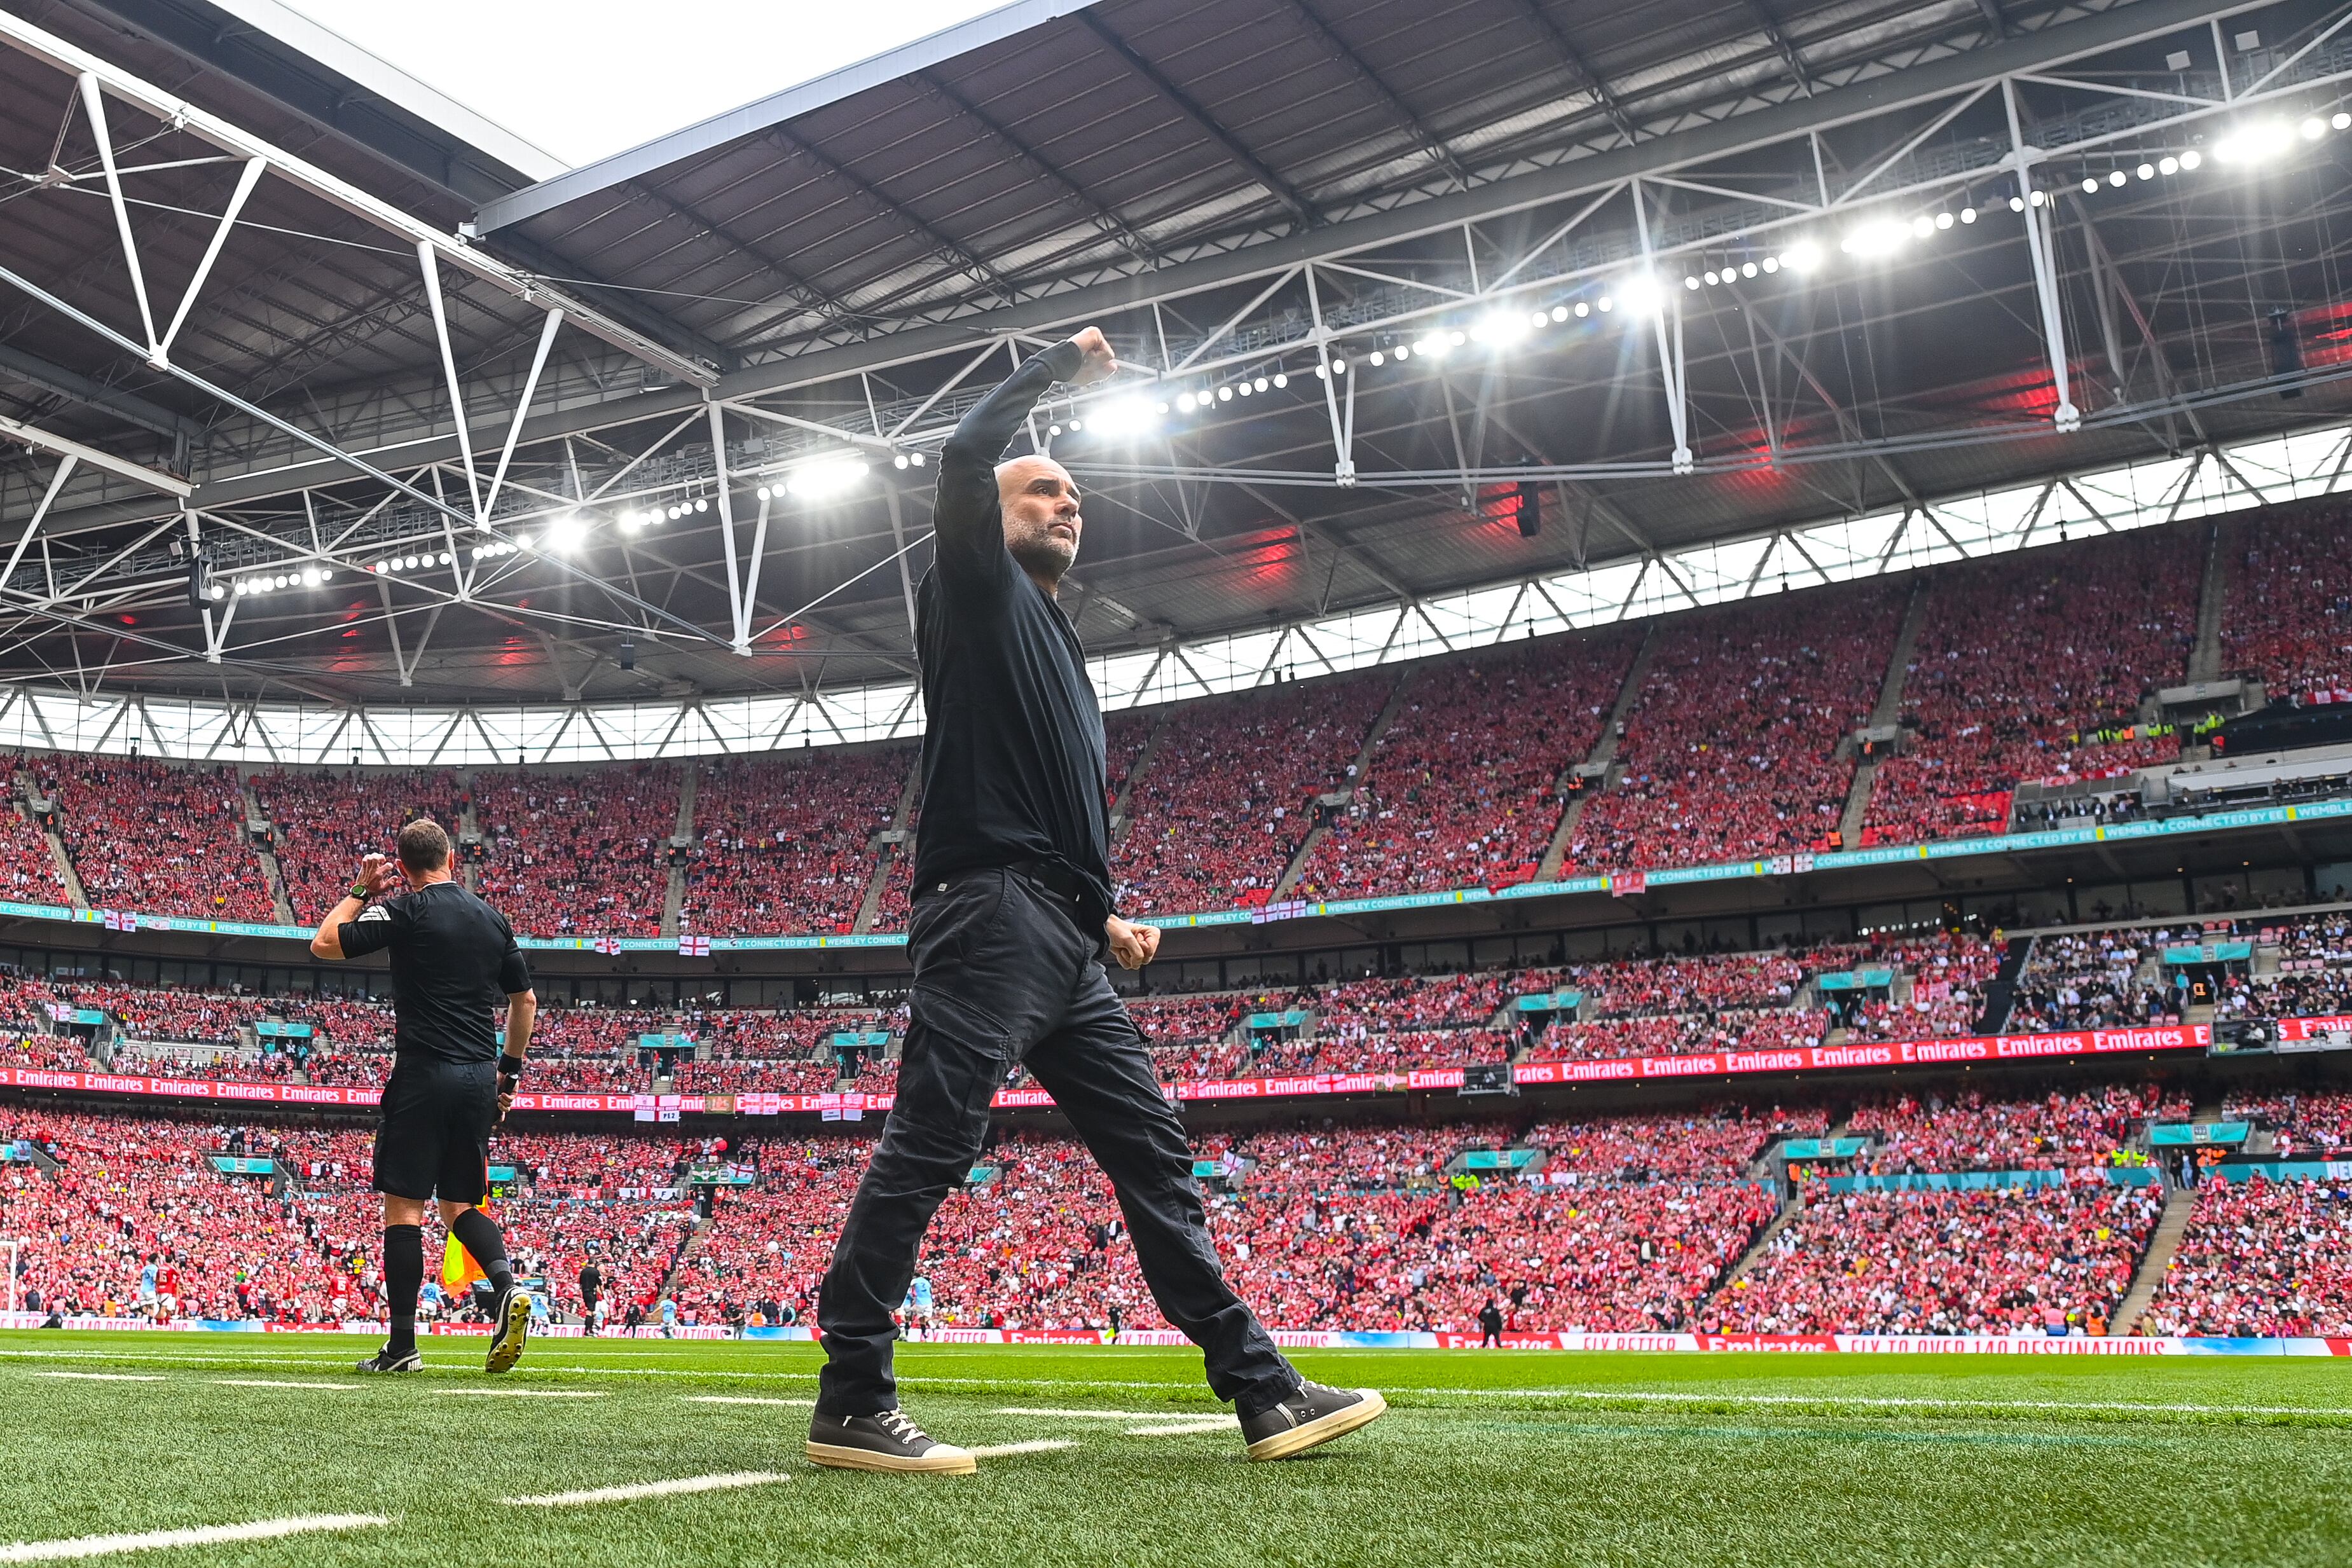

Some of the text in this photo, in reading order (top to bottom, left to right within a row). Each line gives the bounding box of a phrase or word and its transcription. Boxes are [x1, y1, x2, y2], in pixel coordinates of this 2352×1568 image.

[2106, 810, 2283, 837] WEMBLEY CONNECTED BY EE
[1929, 830, 2093, 855] WEMBLEY CONNECTED BY EE
[1817, 848, 1916, 866] CONNECTED BY EE
[1658, 867, 1723, 882] CONNECTED
[1725, 865, 1738, 875] BY
[1740, 864, 1752, 873] EE
[1511, 883, 1569, 895] CONNECTED
[1571, 881, 1584, 890] BY
[9, 905, 64, 918] CONNECTED
[1307, 905, 1317, 914] EE
[1327, 902, 1368, 912] WEMBLEY
[1371, 897, 1427, 908] CONNECTED
[1429, 895, 1440, 904] BY
[1197, 914, 1237, 923] WEMBLEY
[217, 924, 256, 933] WEMBLEY
[258, 927, 307, 937] CONNECTED
[519, 939, 574, 947] NECTED BY EE
[623, 940, 671, 949] CONNECTED
[745, 939, 794, 948] CONNECTED
[809, 938, 818, 946] EE
[827, 936, 909, 946] WEMBLEY CONNECT
[1996, 1035, 2083, 1056] Emirates
[2093, 1030, 2184, 1050] Emirates
[1812, 1047, 1891, 1066] Emirates
[1901, 1041, 1986, 1062] Emirates
[1642, 1057, 1717, 1076] Emirates
[1725, 1052, 1802, 1071] Emirates
[17, 1069, 76, 1087] Emirates
[1515, 1066, 1553, 1081] rates
[1562, 1061, 1633, 1080] Emirates
[85, 1074, 143, 1091] Emirates
[151, 1079, 209, 1095] Emirates
[216, 1082, 274, 1099] Emirates
[282, 1086, 340, 1102] Emirates
[347, 1089, 380, 1104] Emir
[542, 1094, 600, 1109] Emirates
[1708, 1337, 1826, 1352] Emirates
[1888, 1340, 1908, 1353] TO
[1976, 1340, 2008, 1354] 140
[2018, 1340, 2164, 1355] DESTINATIONS
